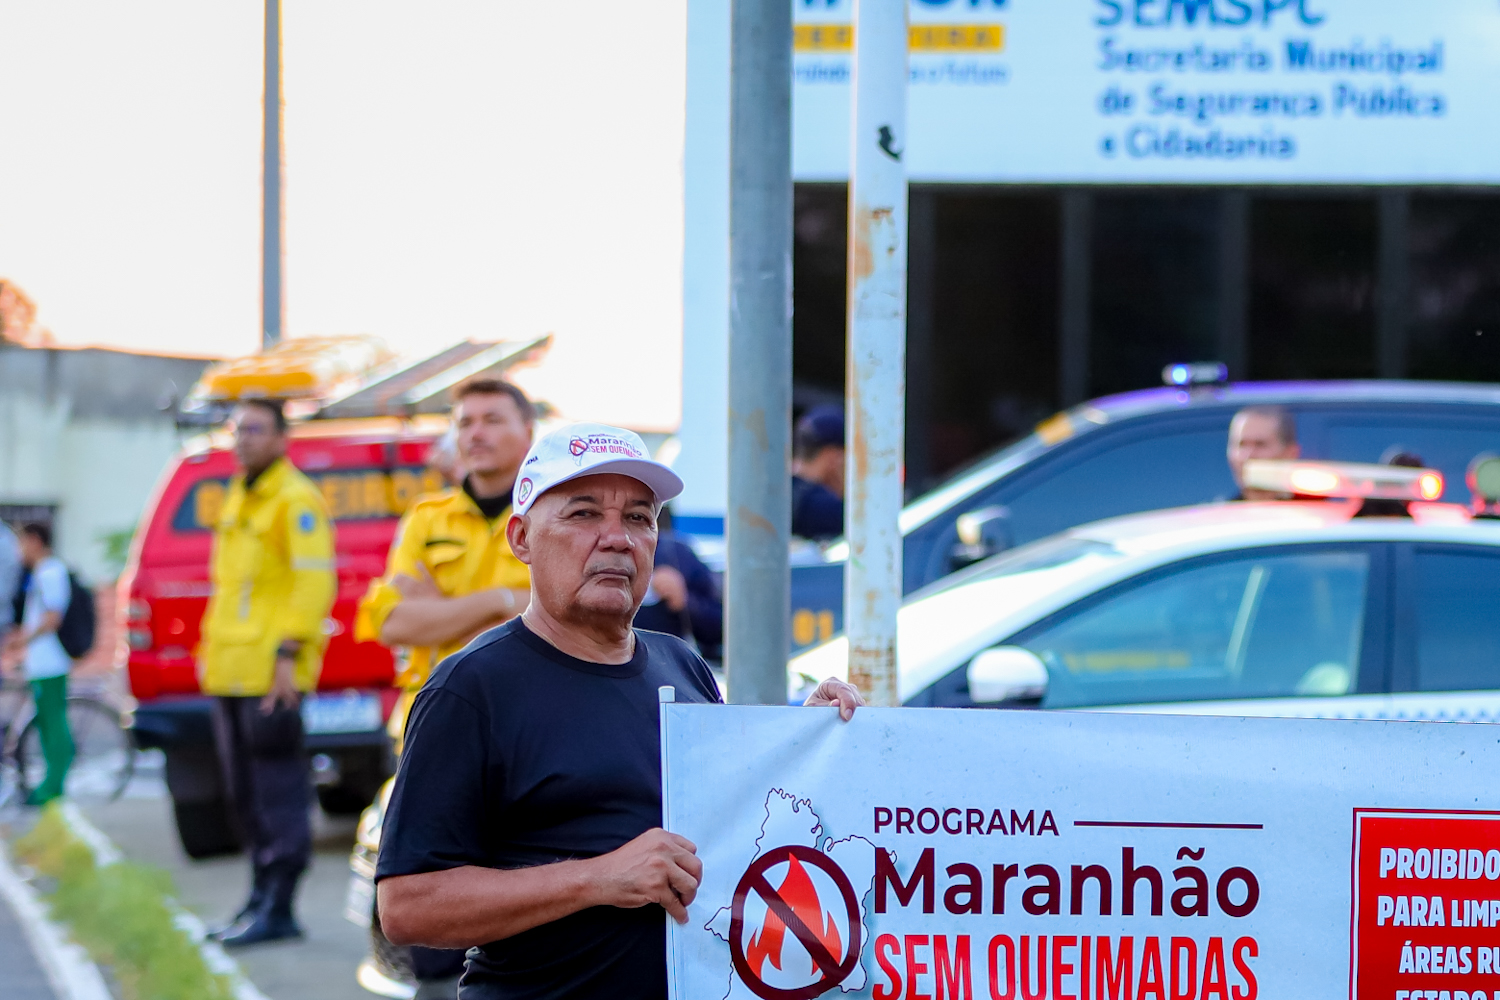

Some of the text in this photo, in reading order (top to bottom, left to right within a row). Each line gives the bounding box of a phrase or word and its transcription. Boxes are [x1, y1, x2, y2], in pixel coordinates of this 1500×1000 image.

[1098, 37, 1444, 76] Secretaria Municipal
[1100, 84, 1135, 114] de
[1125, 126, 1297, 159] Cidadania
[873, 806, 1060, 836] PROGRAMA
[873, 846, 1260, 918] Maranhão
[1377, 895, 1445, 927] PARA
[1399, 940, 1472, 974] ÁREAS
